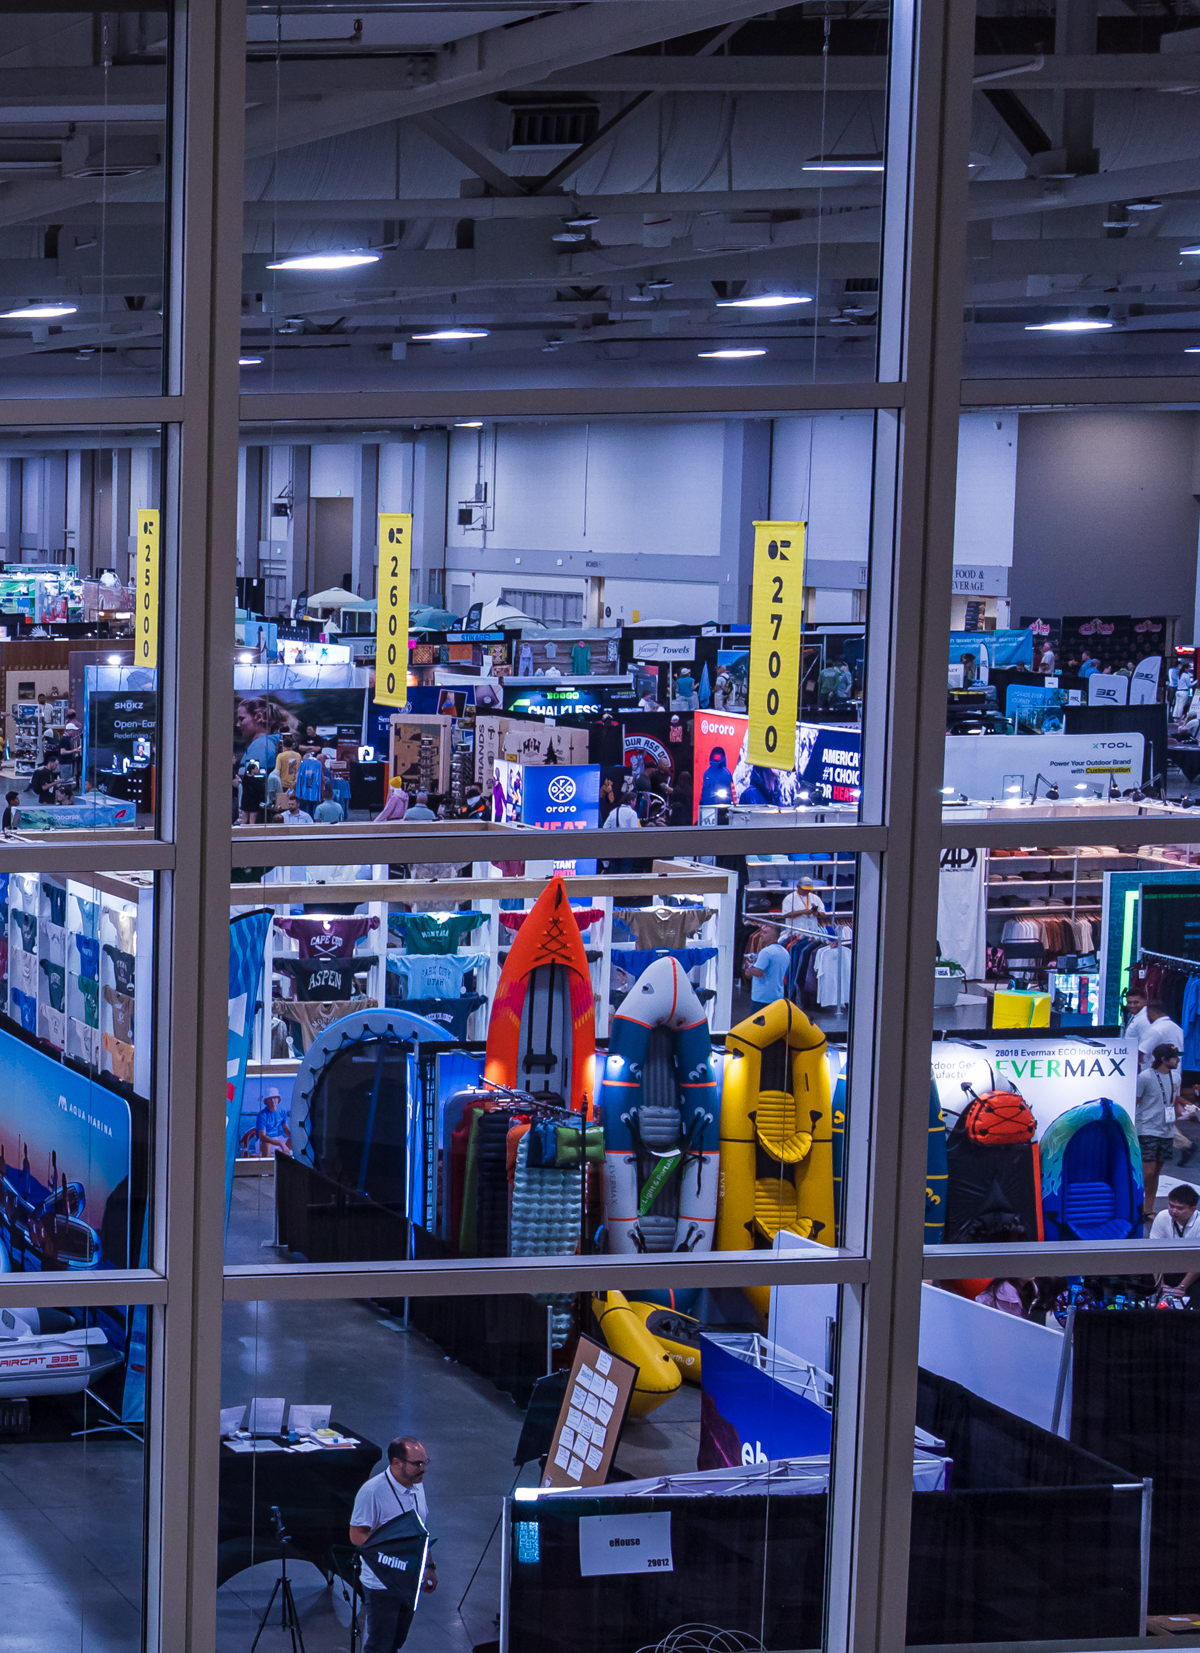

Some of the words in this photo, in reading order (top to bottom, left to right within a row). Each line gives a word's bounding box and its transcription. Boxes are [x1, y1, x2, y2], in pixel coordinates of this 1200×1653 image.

[955, 570, 976, 579] FOOD
[979, 570, 984, 579] &
[143, 544, 152, 658] 25000
[387, 556, 398, 694] 26000
[662, 646, 690, 654] Towels
[765, 576, 784, 753] 27000
[114, 702, 143, 710] SHOKZ
[528, 705, 598, 716] CHALKLESS
[114, 720, 156, 730] Open-Ear
[709, 723, 735, 736] ororo
[644, 740, 660, 752] ASS
[822, 768, 833, 782] #1
[546, 805, 577, 813] ororo
[310, 935, 330, 946] CAPE
[308, 970, 342, 991] ASPEN
[427, 978, 445, 987] UTAH
[995, 1049, 1019, 1057] 28018
[1021, 1049, 1056, 1057] Evermax
[1058, 1048, 1076, 1056] ECO
[1078, 1048, 1112, 1057] Industry
[1114, 1047, 1129, 1055] Ltd.
[995, 1058, 1127, 1078] EVERMAX
[68, 1102, 87, 1121] AQUA
[608, 1164, 618, 1205] EVERMAX
[642, 1185, 657, 1204] Light
[0, 1357, 46, 1368] AIRCAT
[51, 1354, 78, 1364] 335
[609, 1537, 641, 1547] eHouse
[377, 1551, 408, 1571] Torjim
[647, 1558, 670, 1568] 29012
